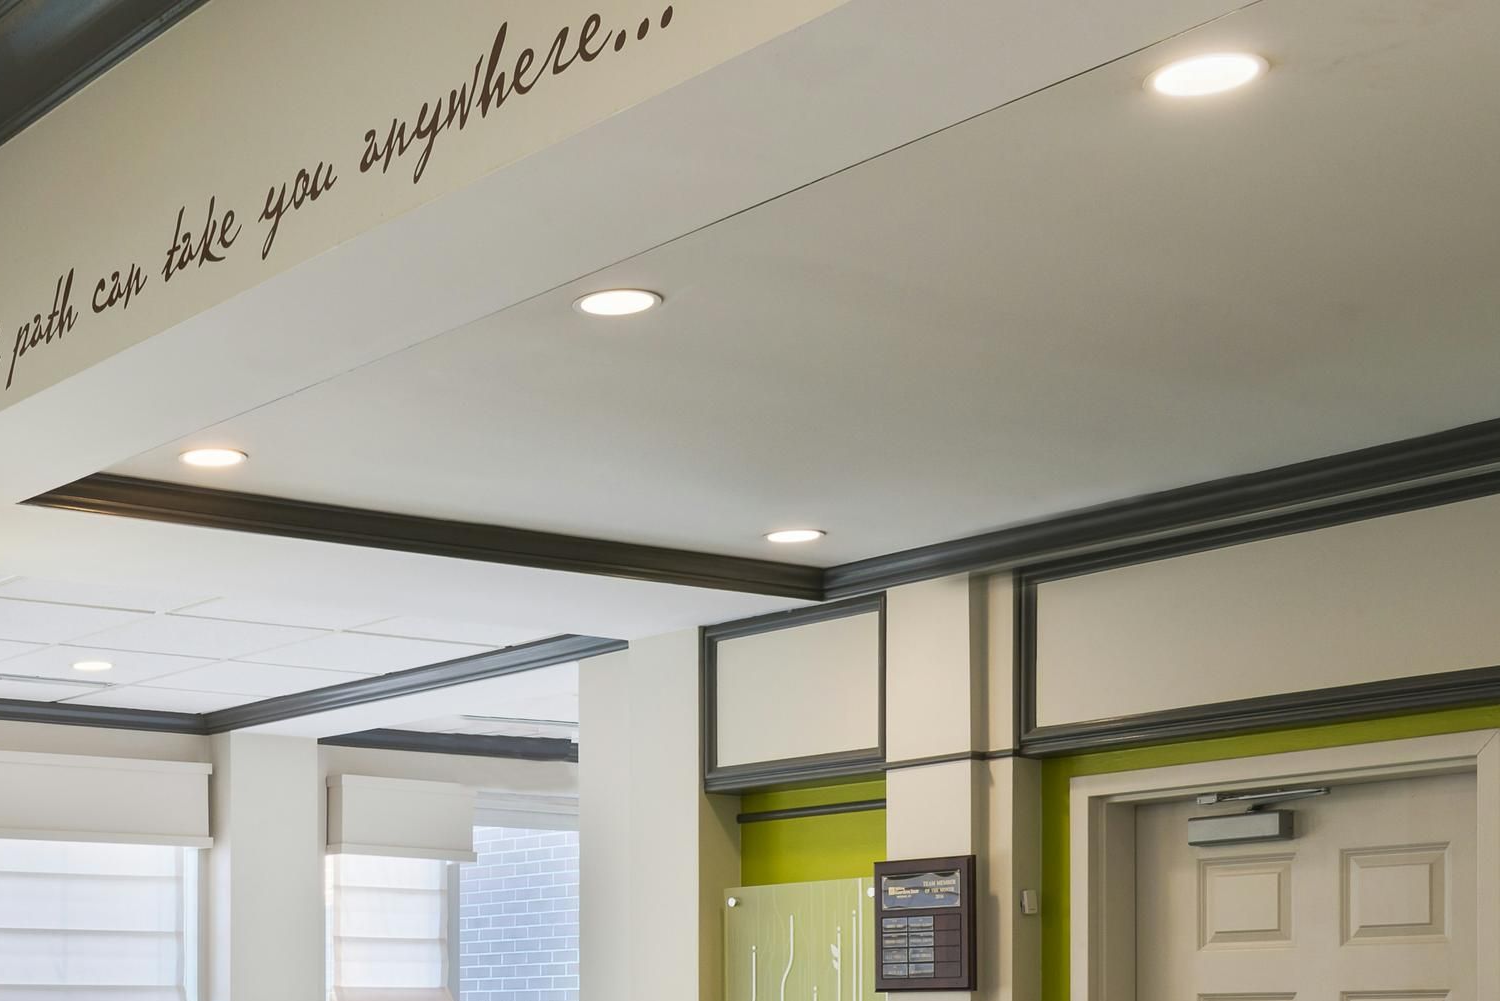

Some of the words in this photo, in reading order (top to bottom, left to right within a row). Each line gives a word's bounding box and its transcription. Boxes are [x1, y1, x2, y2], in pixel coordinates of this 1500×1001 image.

[5, 267, 79, 391] path
[91, 263, 148, 314] can
[160, 195, 243, 283] take
[257, 160, 338, 261] you
[359, 5, 674, 185] anywhere...
